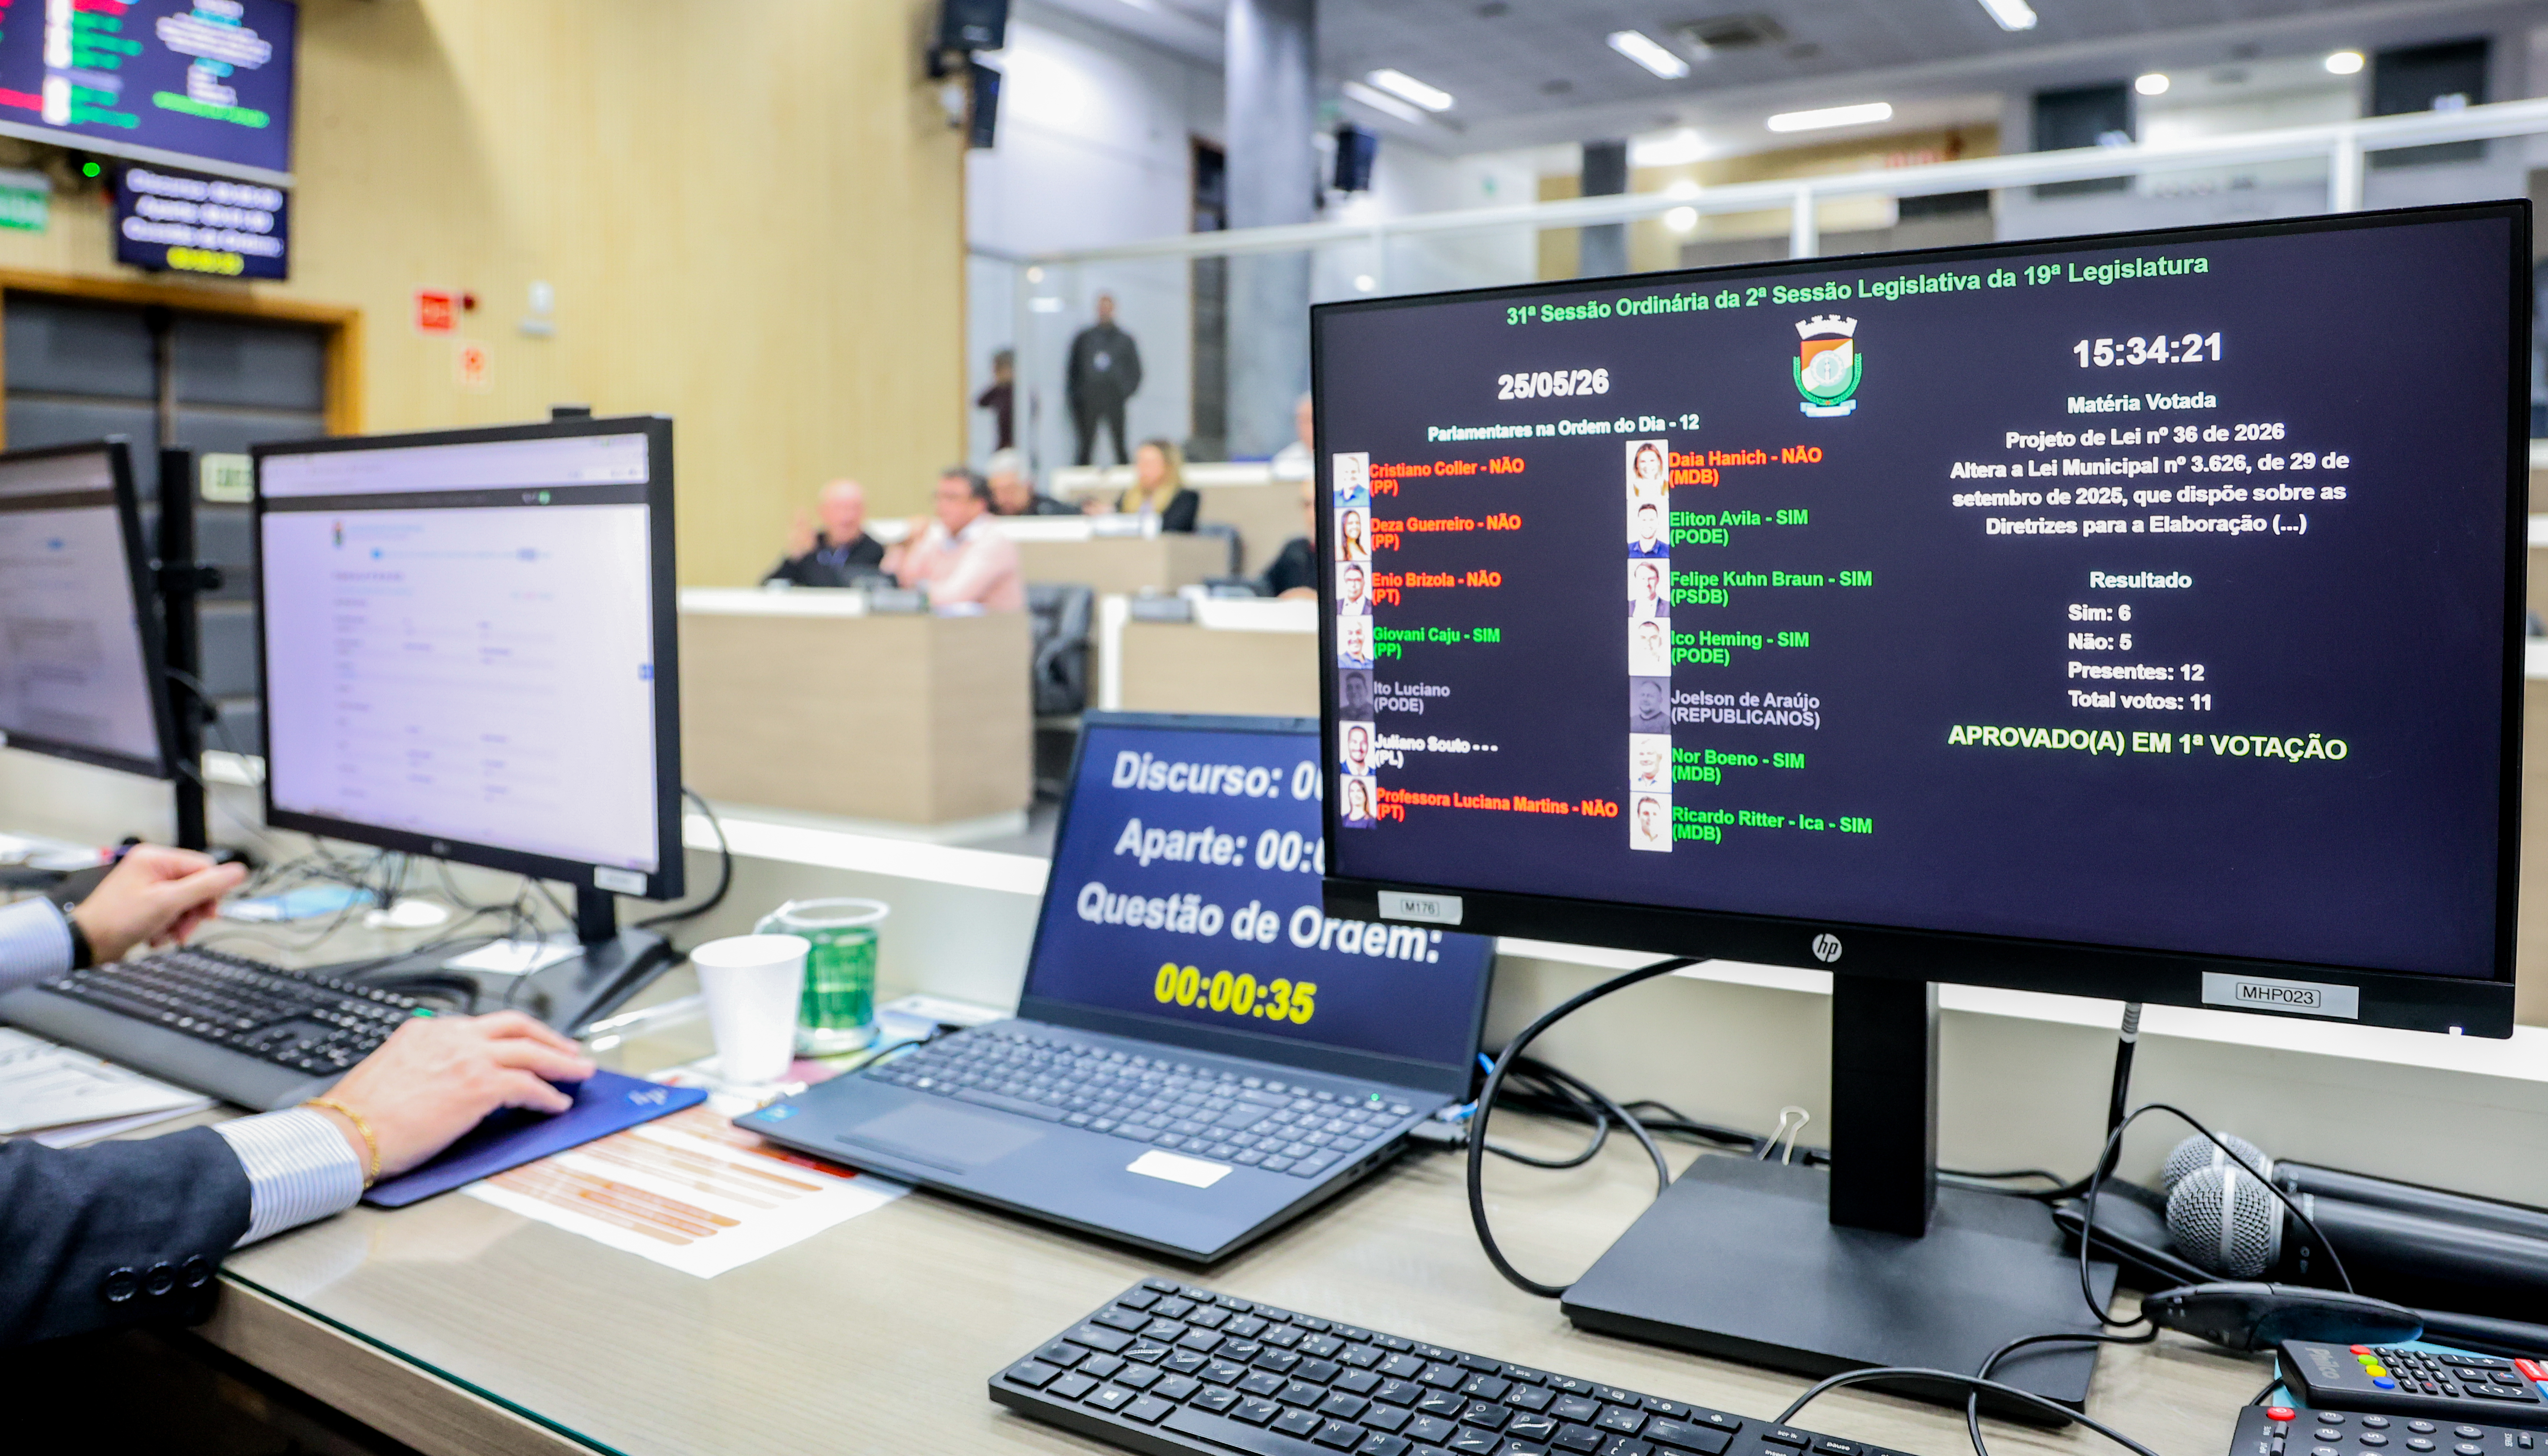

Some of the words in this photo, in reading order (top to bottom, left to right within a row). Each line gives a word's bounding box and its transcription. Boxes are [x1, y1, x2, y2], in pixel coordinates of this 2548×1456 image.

[1506, 305, 1537, 325] 31ª
[1540, 300, 1611, 322] Sessão
[1616, 292, 1709, 316] Ordinária
[1714, 290, 1740, 309] da
[1745, 287, 1767, 307] 2ª
[1772, 281, 1852, 304] Sessão
[1858, 272, 1981, 301] Legislativa
[1987, 268, 2017, 288] da
[2024, 264, 2061, 285] 19ª
[2068, 256, 2209, 285] Legislatura
[2073, 332, 2222, 368] 15:34:21
[1498, 368, 1609, 400] 25/05/26
[2068, 394, 2141, 414] Matéria
[2145, 391, 2217, 410] Votada
[1427, 424, 1533, 442] Parlamentares
[1536, 424, 1555, 437] na
[1557, 419, 1611, 436] Ordem
[1613, 417, 1636, 433] do
[1638, 415, 1666, 432] Dia
[1679, 414, 1700, 430] 12
[2006, 430, 2076, 452] Projeto
[2080, 429, 2106, 446] de
[2111, 428, 2141, 445] Lei
[2147, 427, 2169, 444] nº
[2173, 425, 2198, 443] 36
[2202, 425, 2230, 442] de
[2234, 422, 2285, 441] 2026
[1370, 463, 1433, 478] Cristiano
[1433, 460, 1479, 477] Coller
[1489, 456, 1525, 475] NÃO
[1669, 451, 1705, 469] Daia
[1708, 449, 1768, 467] Hanich
[1781, 445, 1823, 464] NÃO
[1950, 462, 2007, 479] Altera
[2011, 464, 2024, 477] a
[2028, 459, 2058, 477] Lei
[2063, 456, 2159, 478] Municipal
[2164, 456, 2186, 473] nº
[2190, 454, 2252, 475] 3.626,
[2257, 453, 2285, 471] de
[2289, 452, 2316, 470] 29
[2321, 451, 2349, 469] de
[1370, 479, 1399, 497] (PP)
[1669, 468, 1720, 488] (MDB)
[1952, 489, 2042, 507] setembro
[2046, 488, 2071, 505] de
[2075, 487, 2128, 507] 2025,
[2133, 490, 2172, 507] que
[2176, 484, 2248, 506] dispõe
[2252, 483, 2315, 501] sobre
[2320, 486, 2347, 500] as
[1371, 517, 1405, 532] Deza
[1406, 516, 1475, 532] Guerreiro
[1486, 513, 1522, 531] NÃO
[1670, 511, 1716, 527] Eliton
[1719, 510, 1761, 526] Avila
[1776, 509, 1808, 525] SIM
[1986, 517, 2078, 535] Diretrizes
[2083, 520, 2127, 537] para
[2132, 520, 2145, 533] a
[2150, 514, 2267, 536] Elaboração
[2272, 513, 2307, 535] (...)
[1371, 534, 1401, 550] (PP)
[1670, 528, 1729, 547] (PODE)
[1372, 572, 1405, 588] Enio
[1405, 572, 1456, 588] Brizola
[1466, 569, 1502, 587] NÃO
[1670, 571, 1720, 590] Felipe
[1723, 571, 1768, 587] Kuhn
[1772, 571, 1824, 587] Braun
[1839, 571, 1872, 586] SIM
[2090, 571, 2192, 588] Resultado
[1372, 589, 1401, 607] (PT)
[1670, 588, 1729, 608] (PSDB)
[2068, 604, 2113, 621] Sim:
[2118, 604, 2132, 621] 6
[1373, 627, 1425, 643] Giovani
[1428, 627, 1461, 645] Caju
[1473, 628, 1500, 643] SIM
[1671, 630, 1695, 646] Ico
[1699, 630, 1762, 650] Heming
[1777, 631, 1809, 647] SIM
[2068, 632, 2114, 650] Não:
[2119, 633, 2132, 650] 5
[1373, 643, 1402, 660] (PP)
[1671, 647, 1730, 667] (PODE)
[2068, 661, 2174, 680] Presentes:
[2180, 663, 2205, 681] 12
[1373, 681, 1392, 695] Ito
[1394, 681, 1451, 697] Luciano
[1374, 698, 1424, 715] (PODE)
[1671, 690, 1735, 706] Joelson
[1739, 692, 1760, 707] de
[1763, 692, 1820, 710] Araújo
[2068, 690, 2116, 708] Total
[2120, 693, 2184, 710] votos:
[2190, 693, 2211, 711] 11
[1671, 707, 1820, 730] (REPUBLICANOS)
[1375, 733, 1426, 751] Juliano
[1427, 735, 1471, 754] Souto
[1948, 725, 2125, 756] APROVADO(A)
[2132, 731, 2171, 753] EM
[2179, 733, 2204, 754] 1ª
[2209, 733, 2348, 762] VOTAÇÃO
[1375, 750, 1404, 769] (PL)
[1671, 747, 1702, 764] Nor
[1704, 749, 1758, 766] Boeno
[1772, 752, 1805, 769] SIM
[1113, 750, 1283, 797] Discurso:
[1672, 765, 1721, 786] (MDB)
[1376, 788, 1452, 807] Professora
[1453, 792, 1511, 811] Luciana
[1512, 795, 1570, 815] Martins
[1581, 798, 1619, 818] NÃO
[1376, 805, 1406, 823] (PT)
[1672, 806, 1735, 825] Ricardo
[1738, 810, 1785, 828] Ritter
[1799, 814, 1824, 831] Ica
[1839, 816, 1872, 834] SIM
[1115, 818, 1247, 867] Aparte:
[1672, 823, 1721, 844] (MDB)
[1405, 901, 1436, 915] M176
[1077, 882, 1222, 936] Questão
[1231, 901, 1277, 943] de
[1289, 905, 1442, 963] Ordem:
[1815, 933, 1841, 963] hp
[1155, 962, 1317, 1025] 00:00:35
[2243, 986, 2314, 1004] MHP023
[2263, 1425, 2272, 1436] MUTE
[2504, 1433, 2513, 1447] SERVICE
[1826, 1441, 1851, 1451] pause
